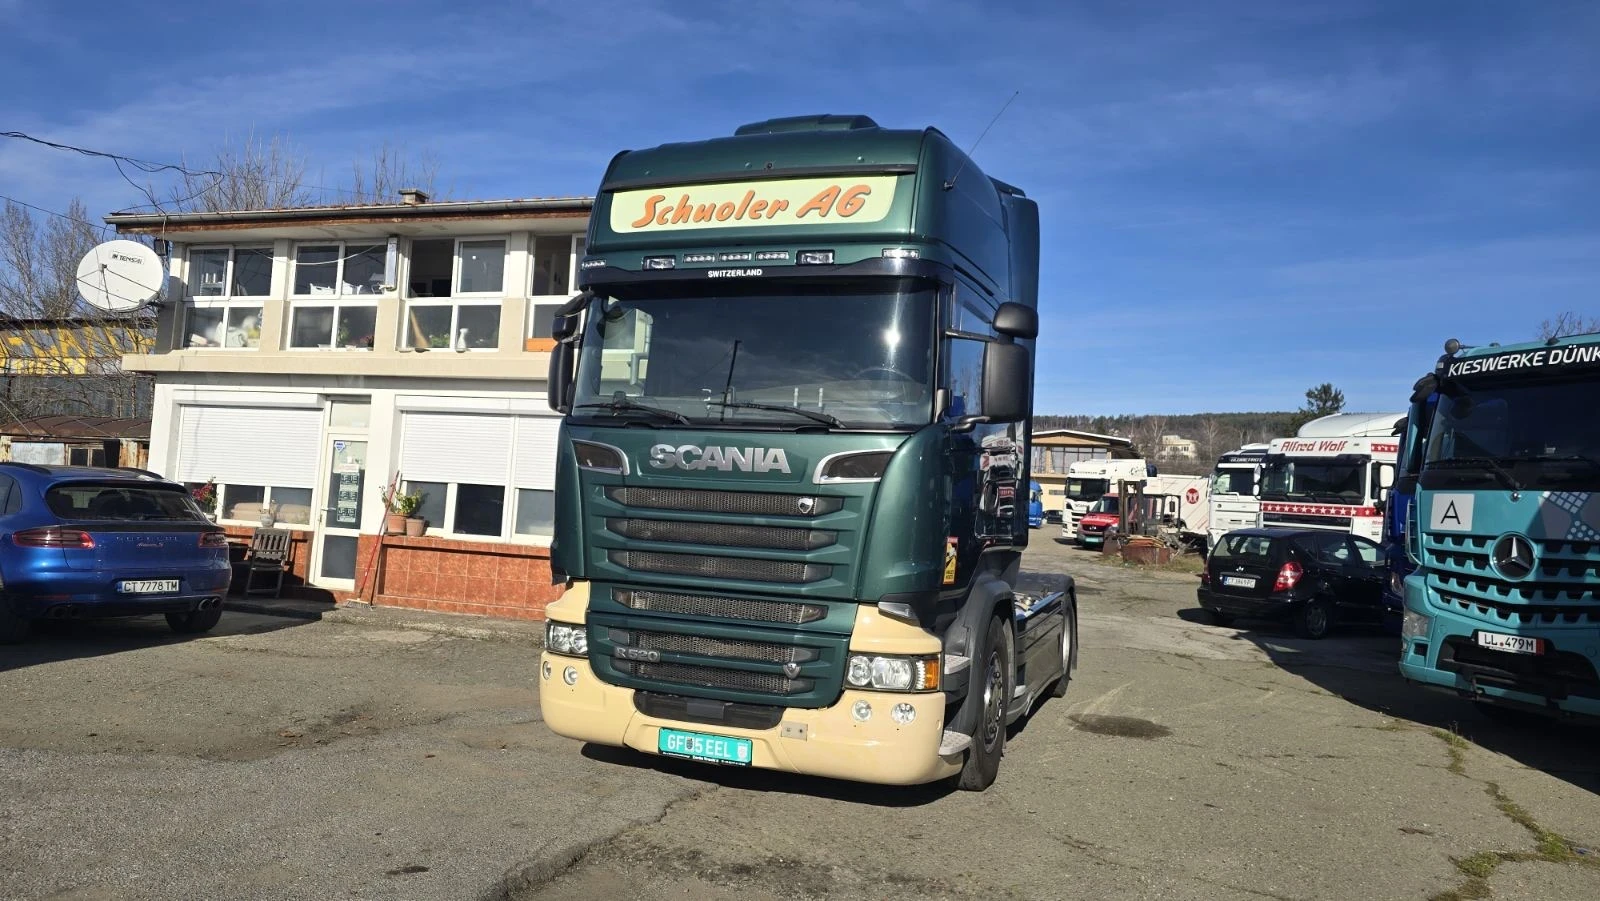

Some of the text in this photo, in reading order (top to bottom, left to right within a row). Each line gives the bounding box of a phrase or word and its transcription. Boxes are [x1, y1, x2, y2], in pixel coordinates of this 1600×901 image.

[631, 184, 872, 229] Schuoler AG
[707, 268, 763, 278] SWITZERLAND
[1447, 350, 1547, 377] KIESWERKE
[1280, 440, 1349, 452] Alfred Wolf
[649, 443, 792, 474] SCANIA
[1440, 499, 1461, 525] A
[140, 581, 164, 592] 7778
[1484, 633, 1498, 646] LL
